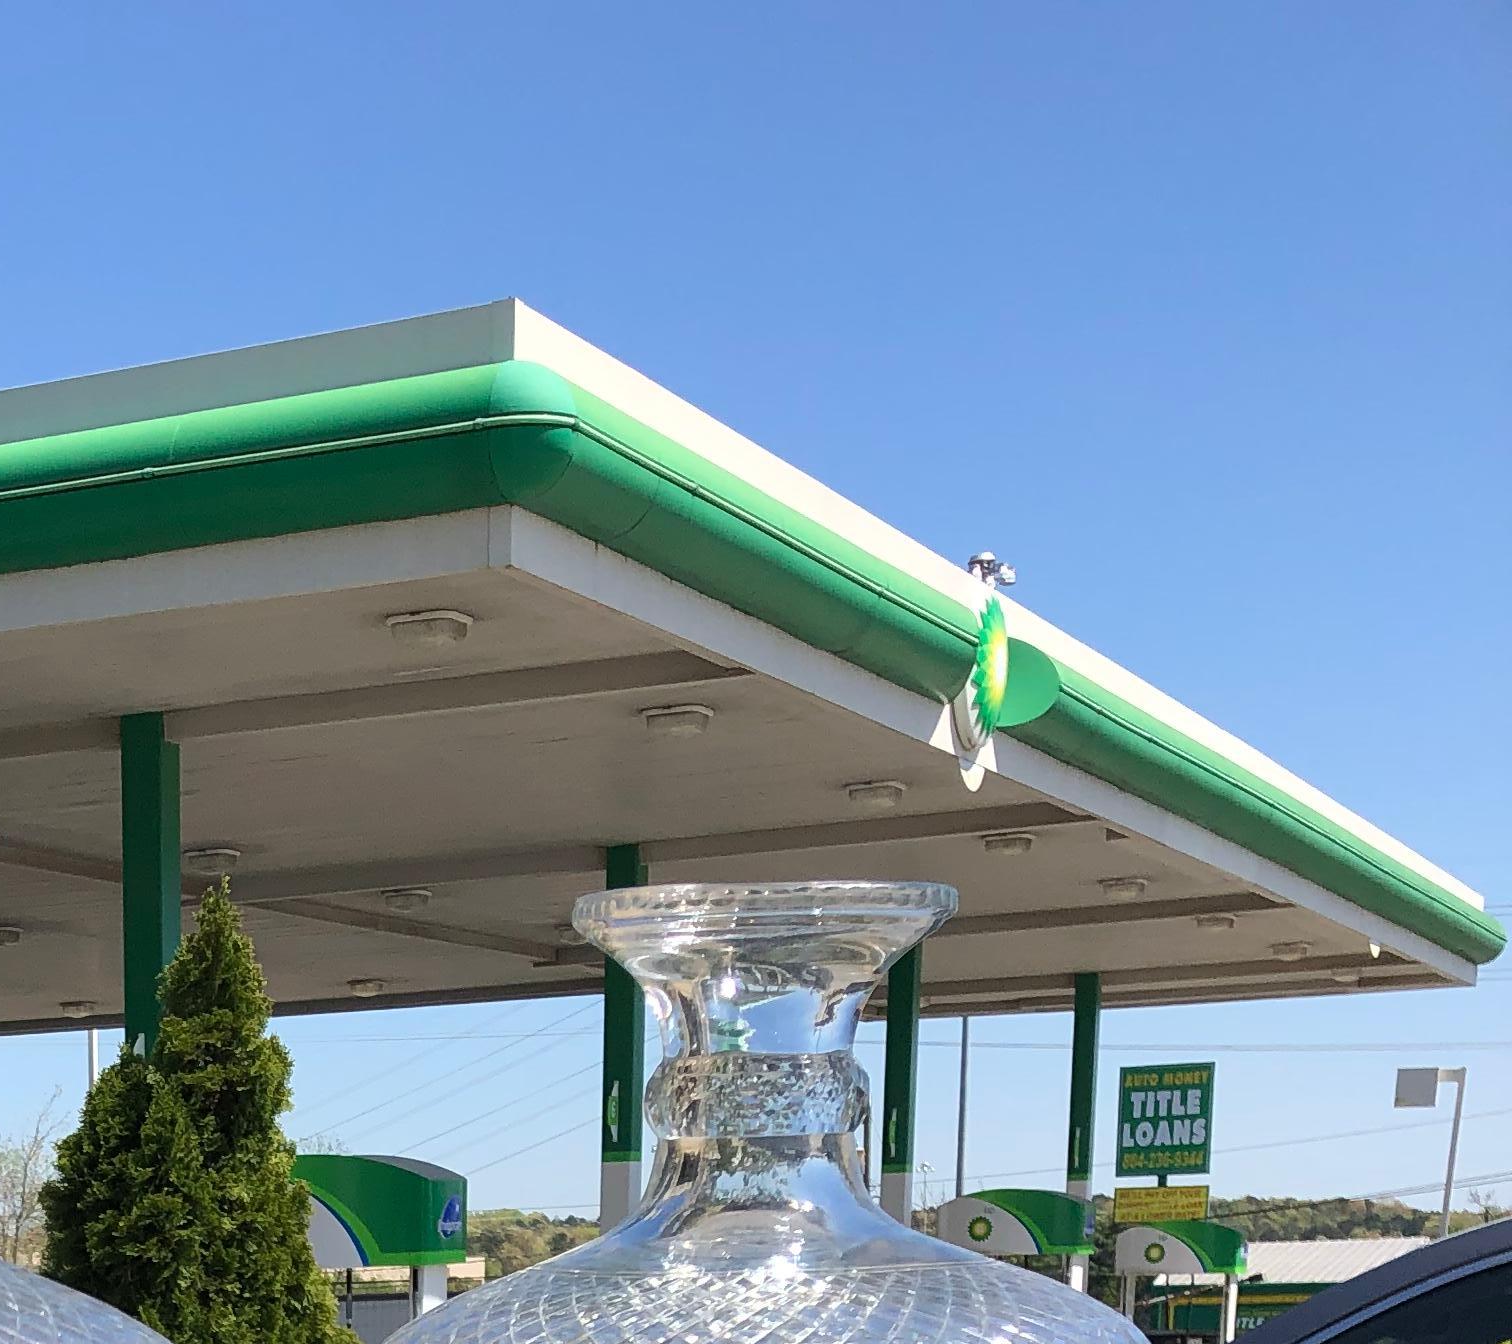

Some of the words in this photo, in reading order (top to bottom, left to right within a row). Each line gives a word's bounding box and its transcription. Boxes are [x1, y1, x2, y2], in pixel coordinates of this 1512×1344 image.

[1124, 1072, 1159, 1088] AUTO
[1162, 1071, 1208, 1086] MONEY
[1130, 1089, 1202, 1118] TITLE
[1122, 1118, 1207, 1147] LOANS
